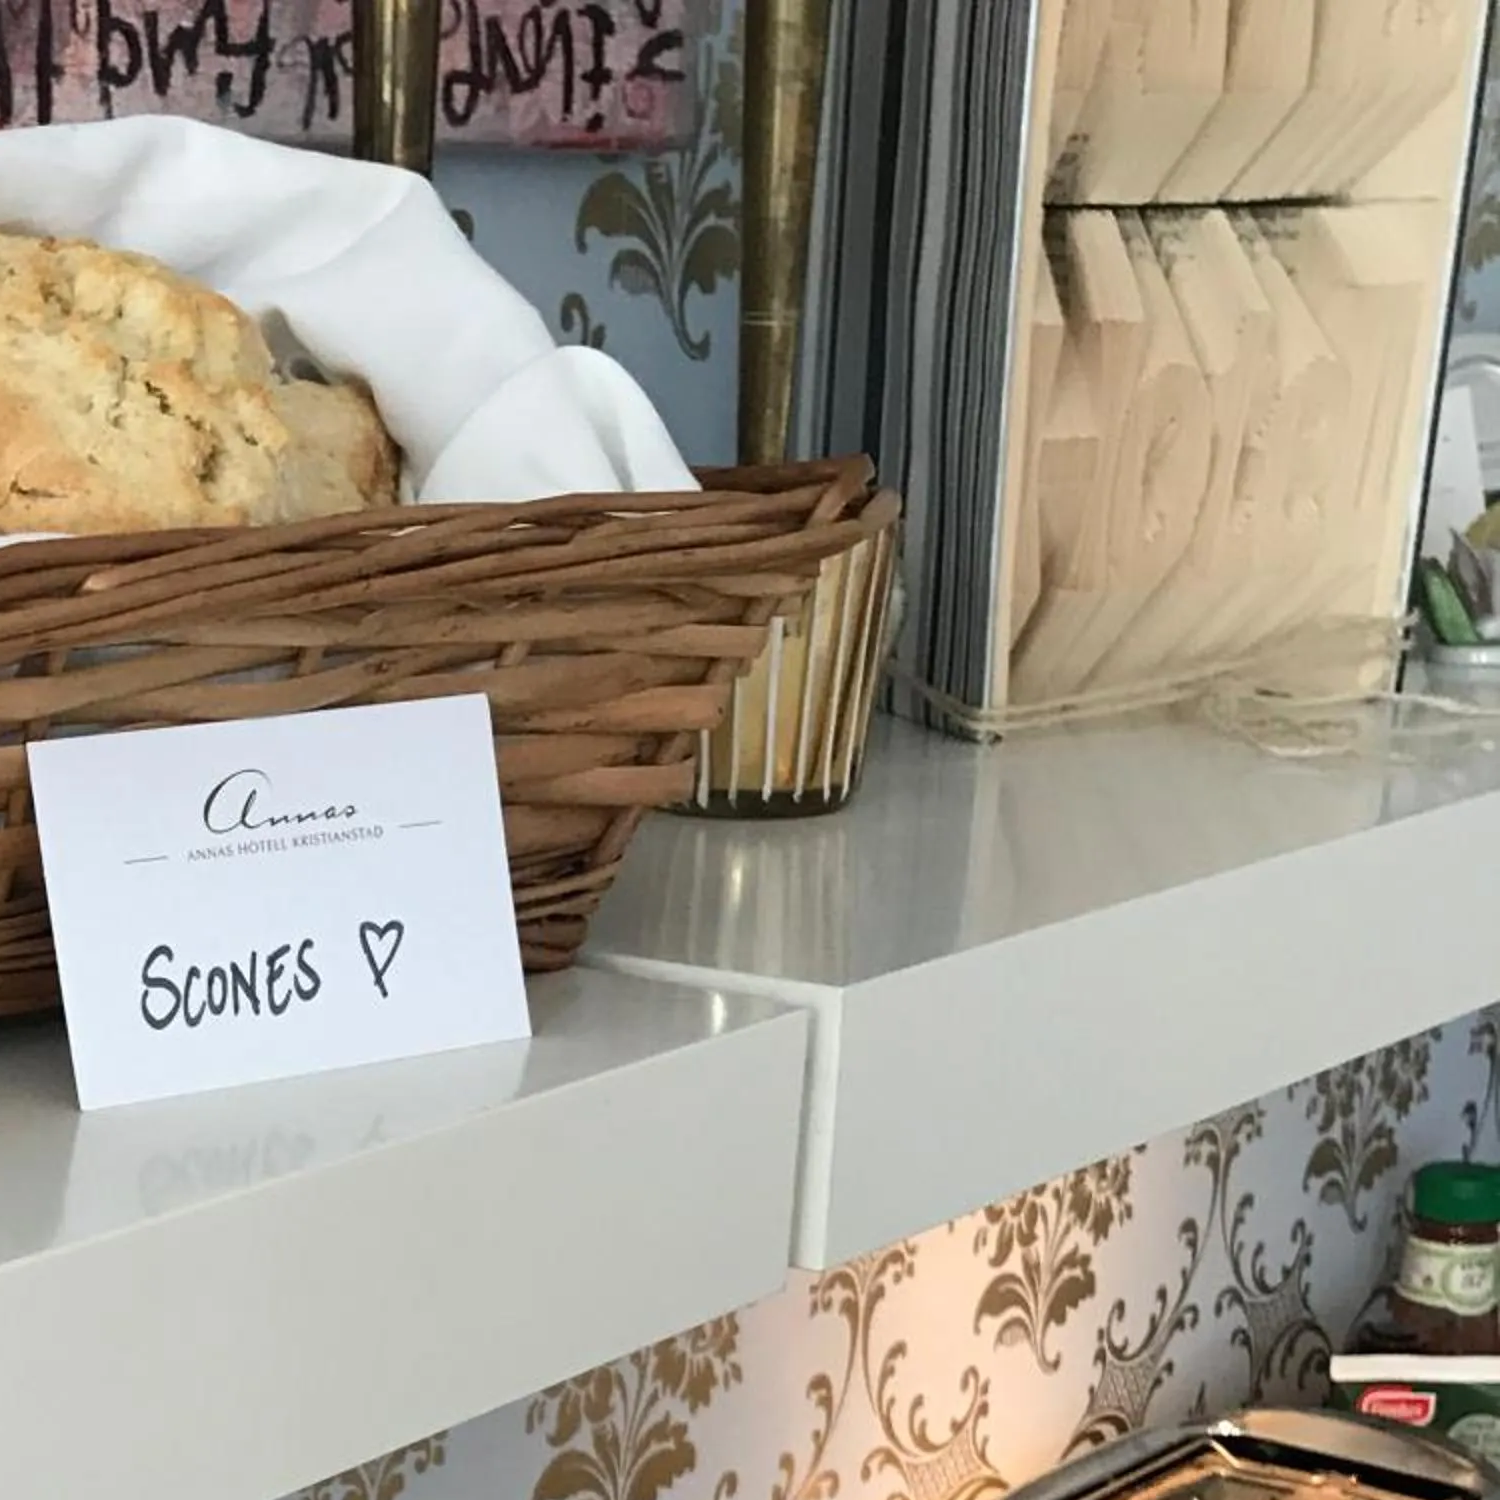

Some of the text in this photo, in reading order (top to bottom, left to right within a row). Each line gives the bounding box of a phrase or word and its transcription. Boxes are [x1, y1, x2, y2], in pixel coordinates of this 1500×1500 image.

[202, 767, 357, 835] Annas
[186, 824, 385, 863] ANNAS HOTELL KRISTIANSTAD
[140, 938, 322, 1031] SCONES
